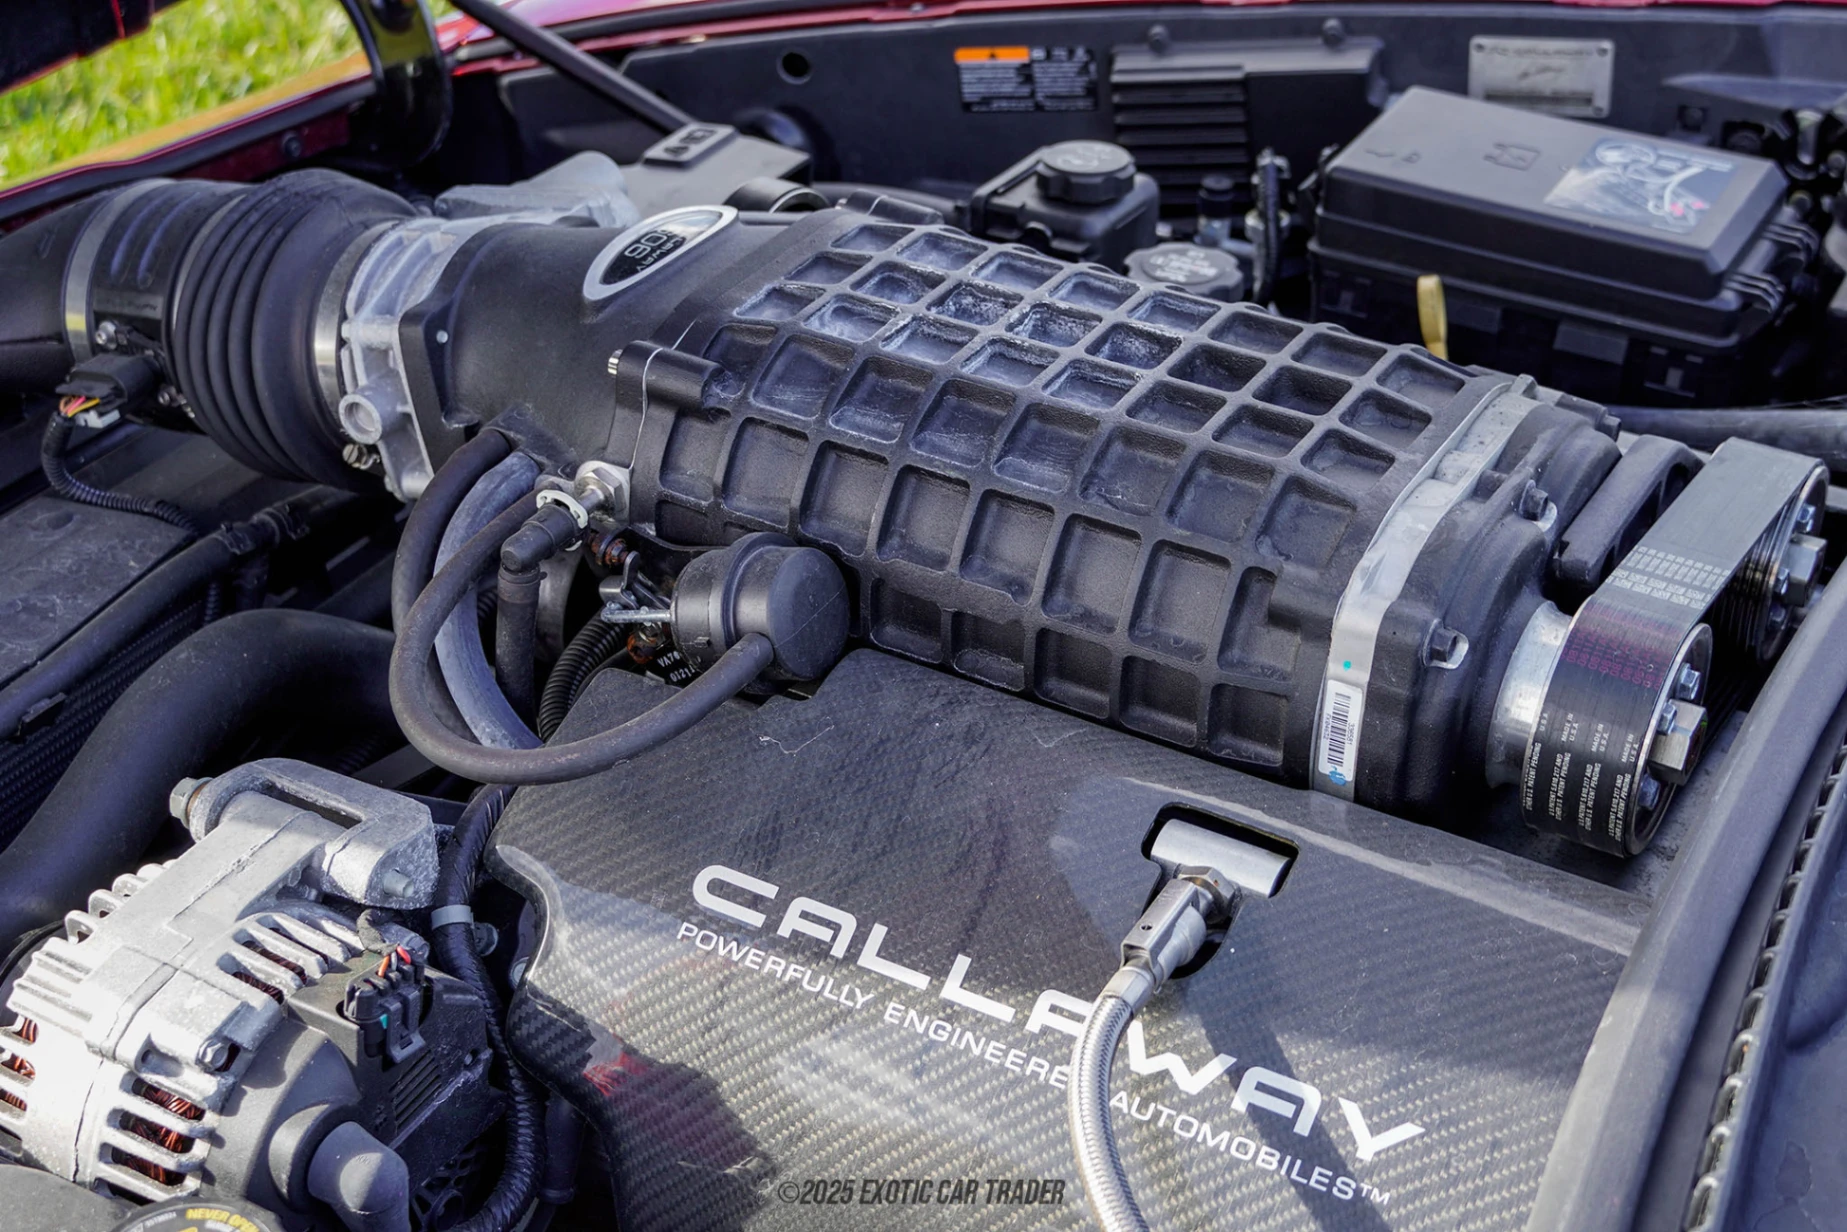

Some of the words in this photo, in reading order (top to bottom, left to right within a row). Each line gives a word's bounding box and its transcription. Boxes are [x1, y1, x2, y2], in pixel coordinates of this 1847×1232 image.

[1561, 722, 1571, 741] MADE
[1591, 732, 1601, 752] MADE
[1531, 742, 1542, 767] PENDING
[1621, 743, 1631, 762] MADE
[1560, 752, 1571, 777] PENDING
[1527, 767, 1536, 787] PATENT
[1590, 762, 1601, 788] PENDING
[1557, 777, 1566, 797] PATENT
[1620, 773, 1631, 799] PENDING
[1587, 787, 1596, 808] PATENT
[1617, 799, 1625, 818] PATENT
[677, 922, 874, 1010] POWERFULLY
[884, 1004, 1072, 1090] ENGINEERE
[693, 865, 1426, 1162] CALLAWAY
[186, 1208, 230, 1222] NEVER
